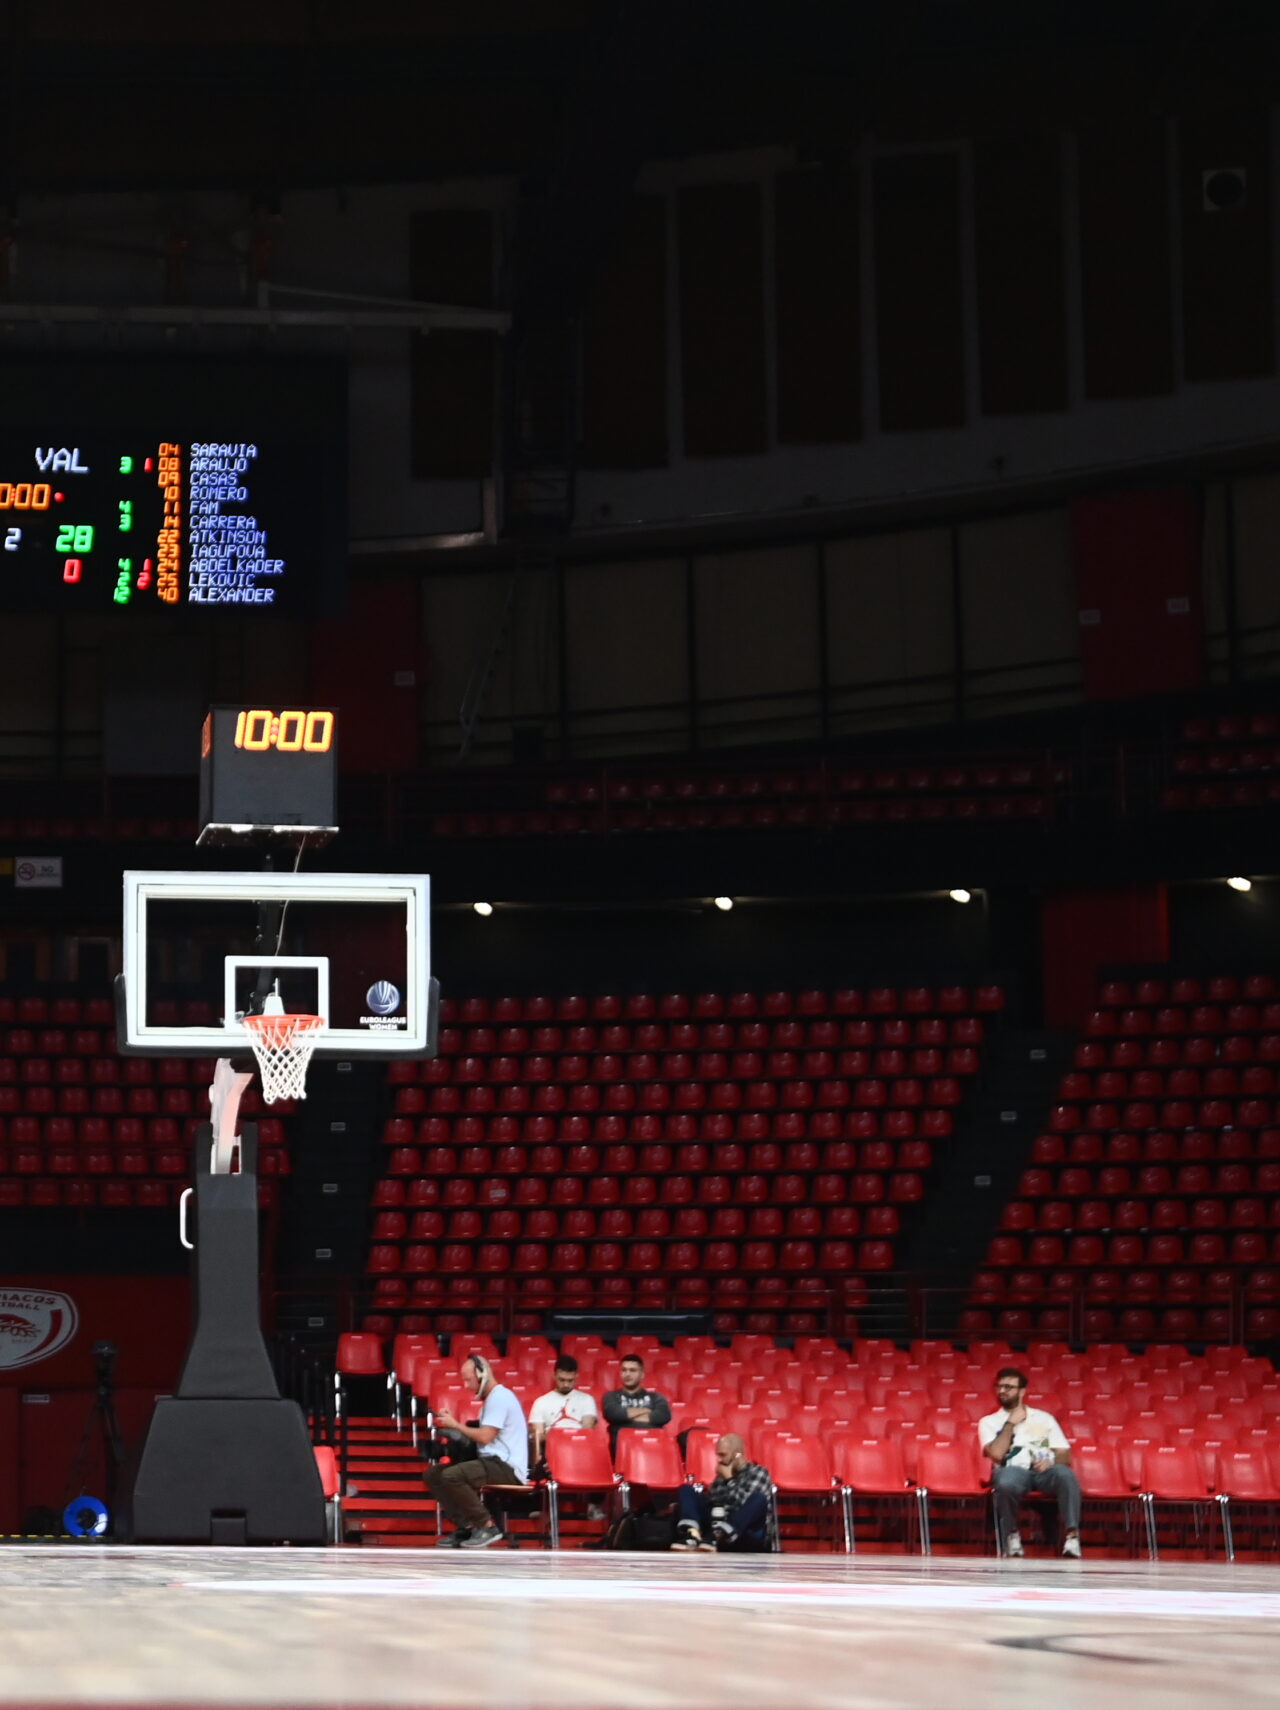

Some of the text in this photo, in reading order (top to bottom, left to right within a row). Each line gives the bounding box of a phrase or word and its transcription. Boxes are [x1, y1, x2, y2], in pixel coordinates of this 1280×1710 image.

[158, 442, 257, 458] 04 SARAVIA
[35, 447, 89, 473] VAL
[119, 456, 247, 474] 3 1 08 ARAUJO
[158, 471, 238, 486] 09 CASAS
[163, 486, 247, 500] 10 ROMERO
[119, 500, 219, 515] 4 11 FAM
[119, 514, 256, 532] 3 14 CARRERA
[4, 528, 21, 551] 2
[55, 525, 94, 553] 28
[157, 529, 266, 544] 22 ATKINSON
[157, 544, 265, 559] 23 IAGUPOVA
[63, 559, 82, 583] 0
[118, 558, 131, 572] 4
[157, 559, 179, 572] 24
[189, 559, 284, 574] ABDELKADER
[117, 571, 255, 590] 2 2 25 LEKOVIC
[157, 587, 179, 602] 40
[188, 587, 274, 603] ALEXANDER
[234, 710, 334, 752] 10:00
[359, 1016, 407, 1024] EUROLEAGUE
